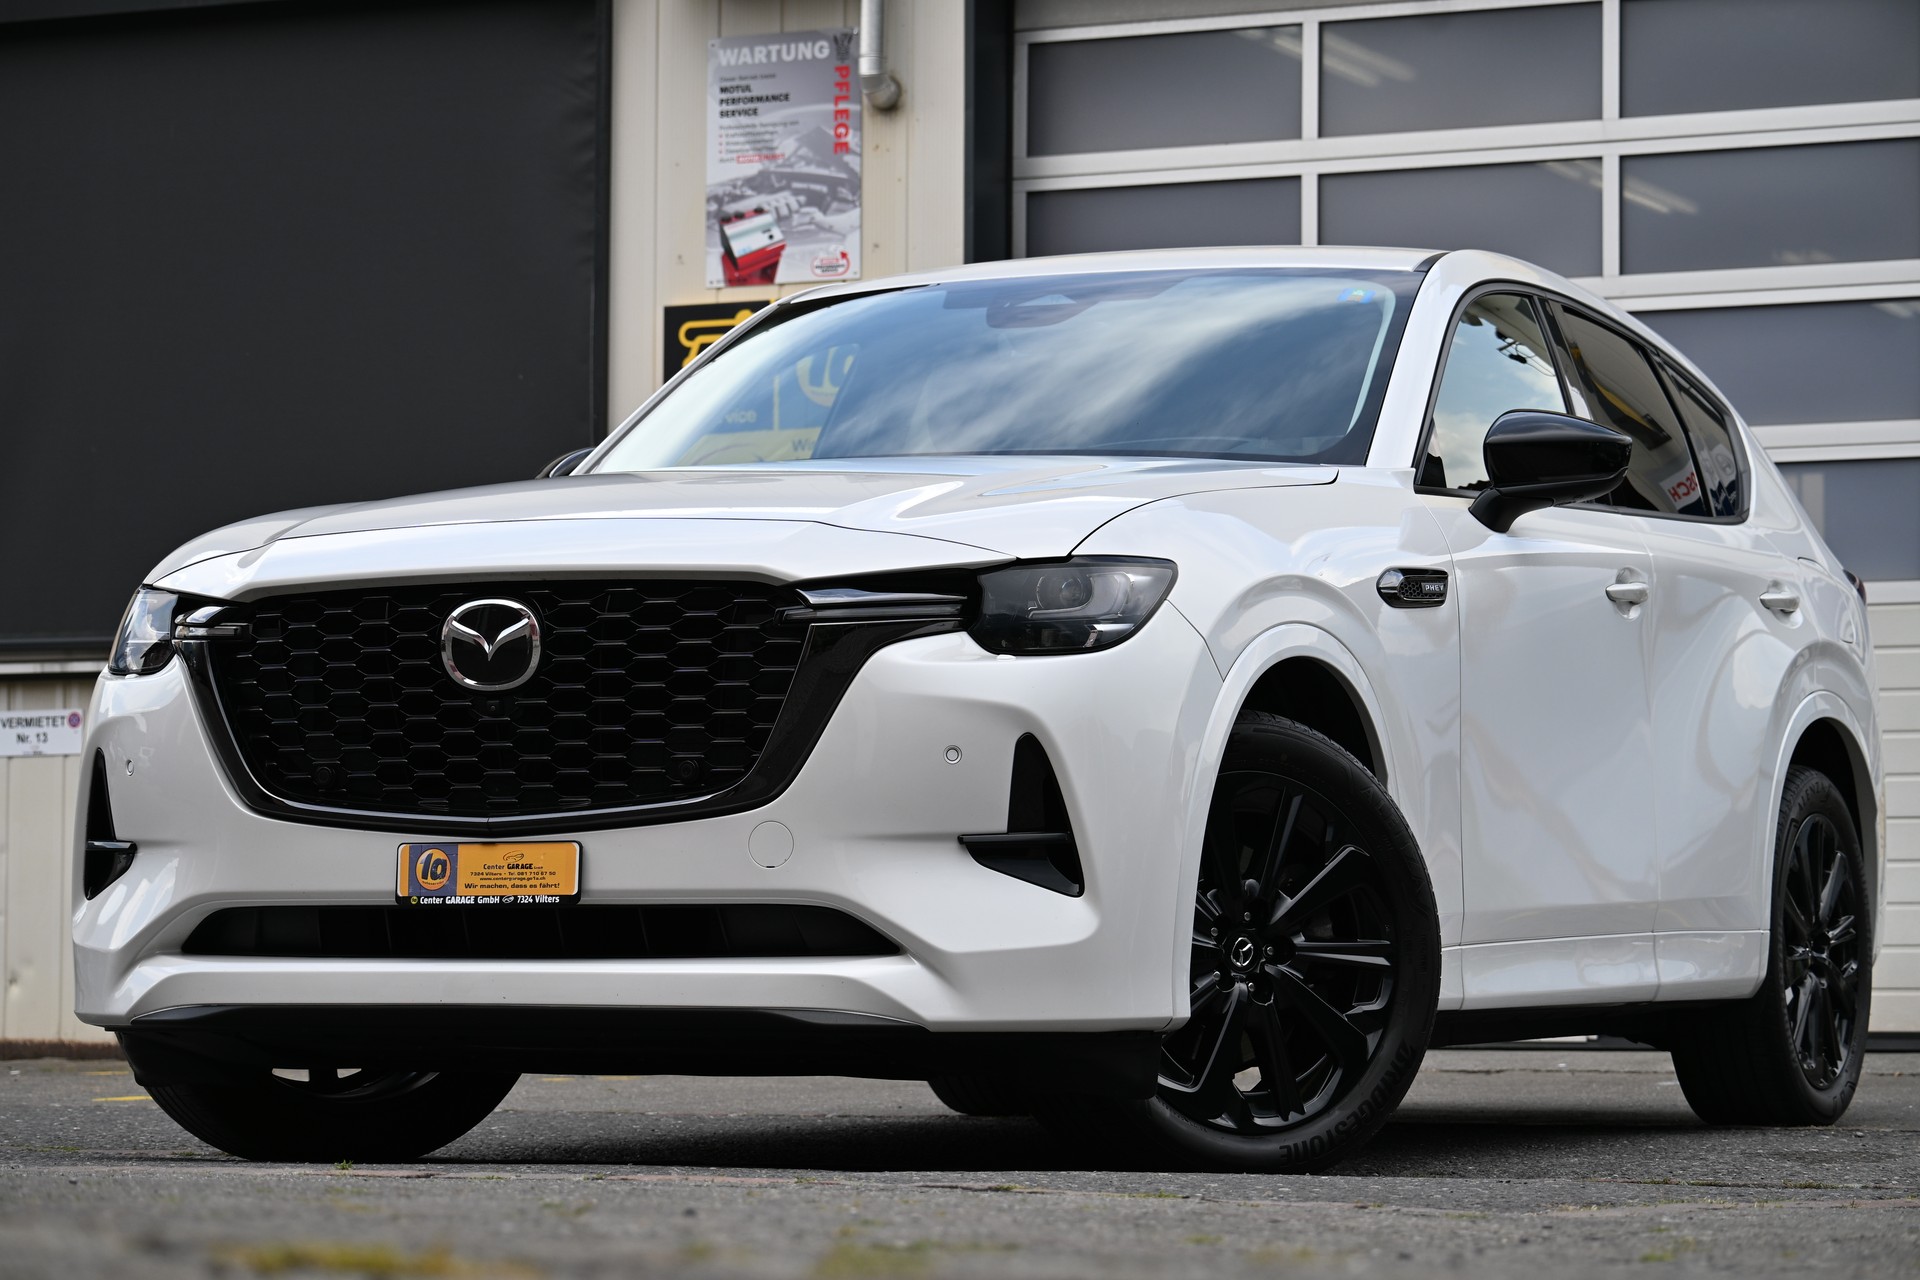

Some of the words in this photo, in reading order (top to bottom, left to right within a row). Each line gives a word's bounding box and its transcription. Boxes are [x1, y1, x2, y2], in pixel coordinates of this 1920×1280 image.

[719, 40, 830, 67] WARTUNG
[720, 84, 752, 94] MOTUL
[720, 92, 790, 106] PERFORMANCE
[720, 108, 758, 118] SERVICE
[834, 65, 850, 155] PFLEGE
[1425, 584, 1445, 592] PHEV
[0, 716, 65, 729] VERMIETET
[16, 733, 32, 744] Nr.
[36, 732, 48, 744] 13
[420, 896, 443, 904] Center
[445, 896, 475, 904] GARAGE
[477, 895, 500, 904] GmbH
[517, 895, 533, 904] 7324
[535, 895, 560, 904] Vilters
[1279, 1039, 1416, 1165] BRIDGESTONE
